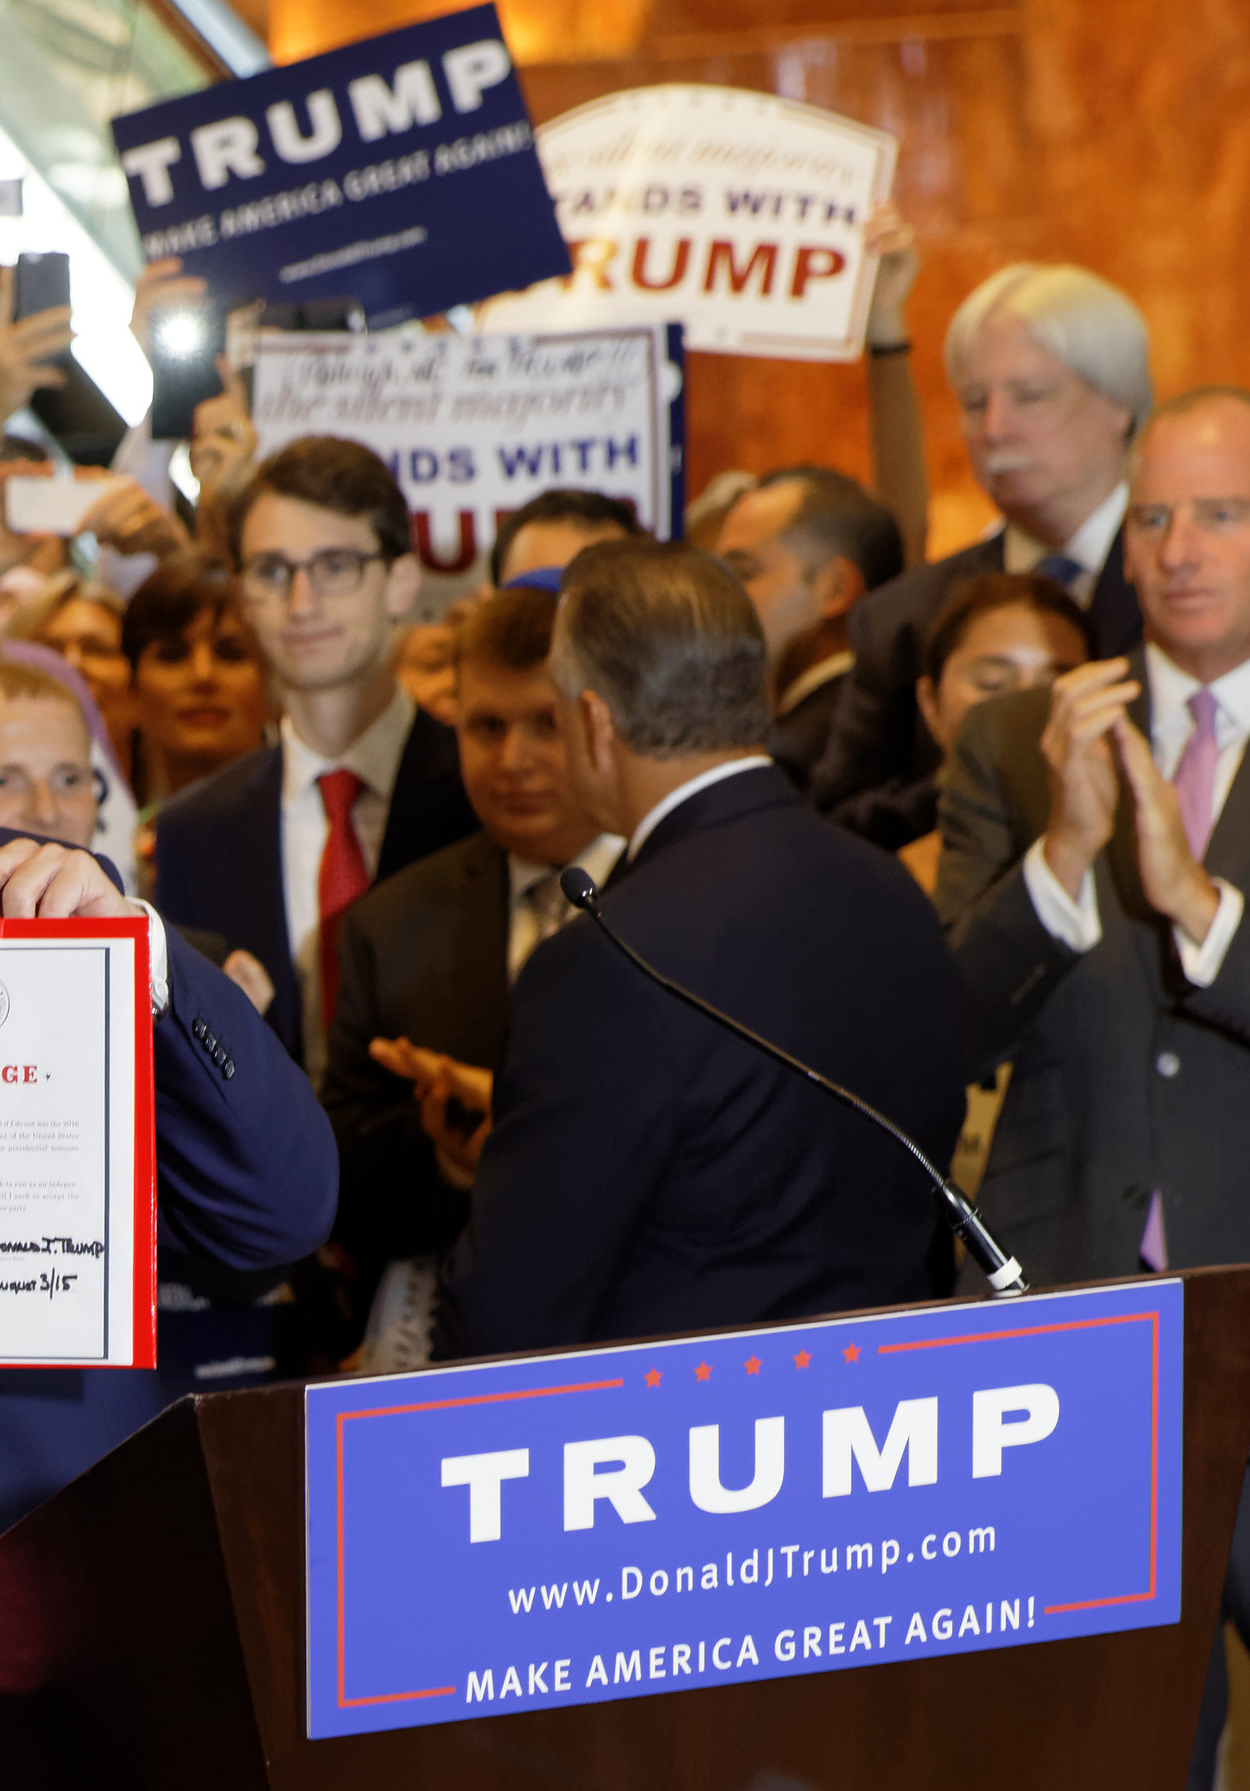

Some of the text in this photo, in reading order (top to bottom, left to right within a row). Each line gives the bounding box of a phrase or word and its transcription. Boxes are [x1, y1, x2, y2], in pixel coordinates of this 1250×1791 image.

[121, 38, 512, 208] TRUMP
[141, 214, 218, 258] MAKE
[220, 178, 344, 240] AMERICA
[344, 148, 432, 203] GREAT
[724, 187, 857, 228] WITH
[562, 235, 847, 301] RUMP
[497, 432, 640, 483] WITH
[39, 1267, 79, 1300] 3/15
[440, 1382, 1061, 1544] TRUMP
[508, 1523, 998, 1615] www.DonaldJTrump.com
[465, 1595, 1038, 1704] MAKE AMERICA GREAT AGAIN!
